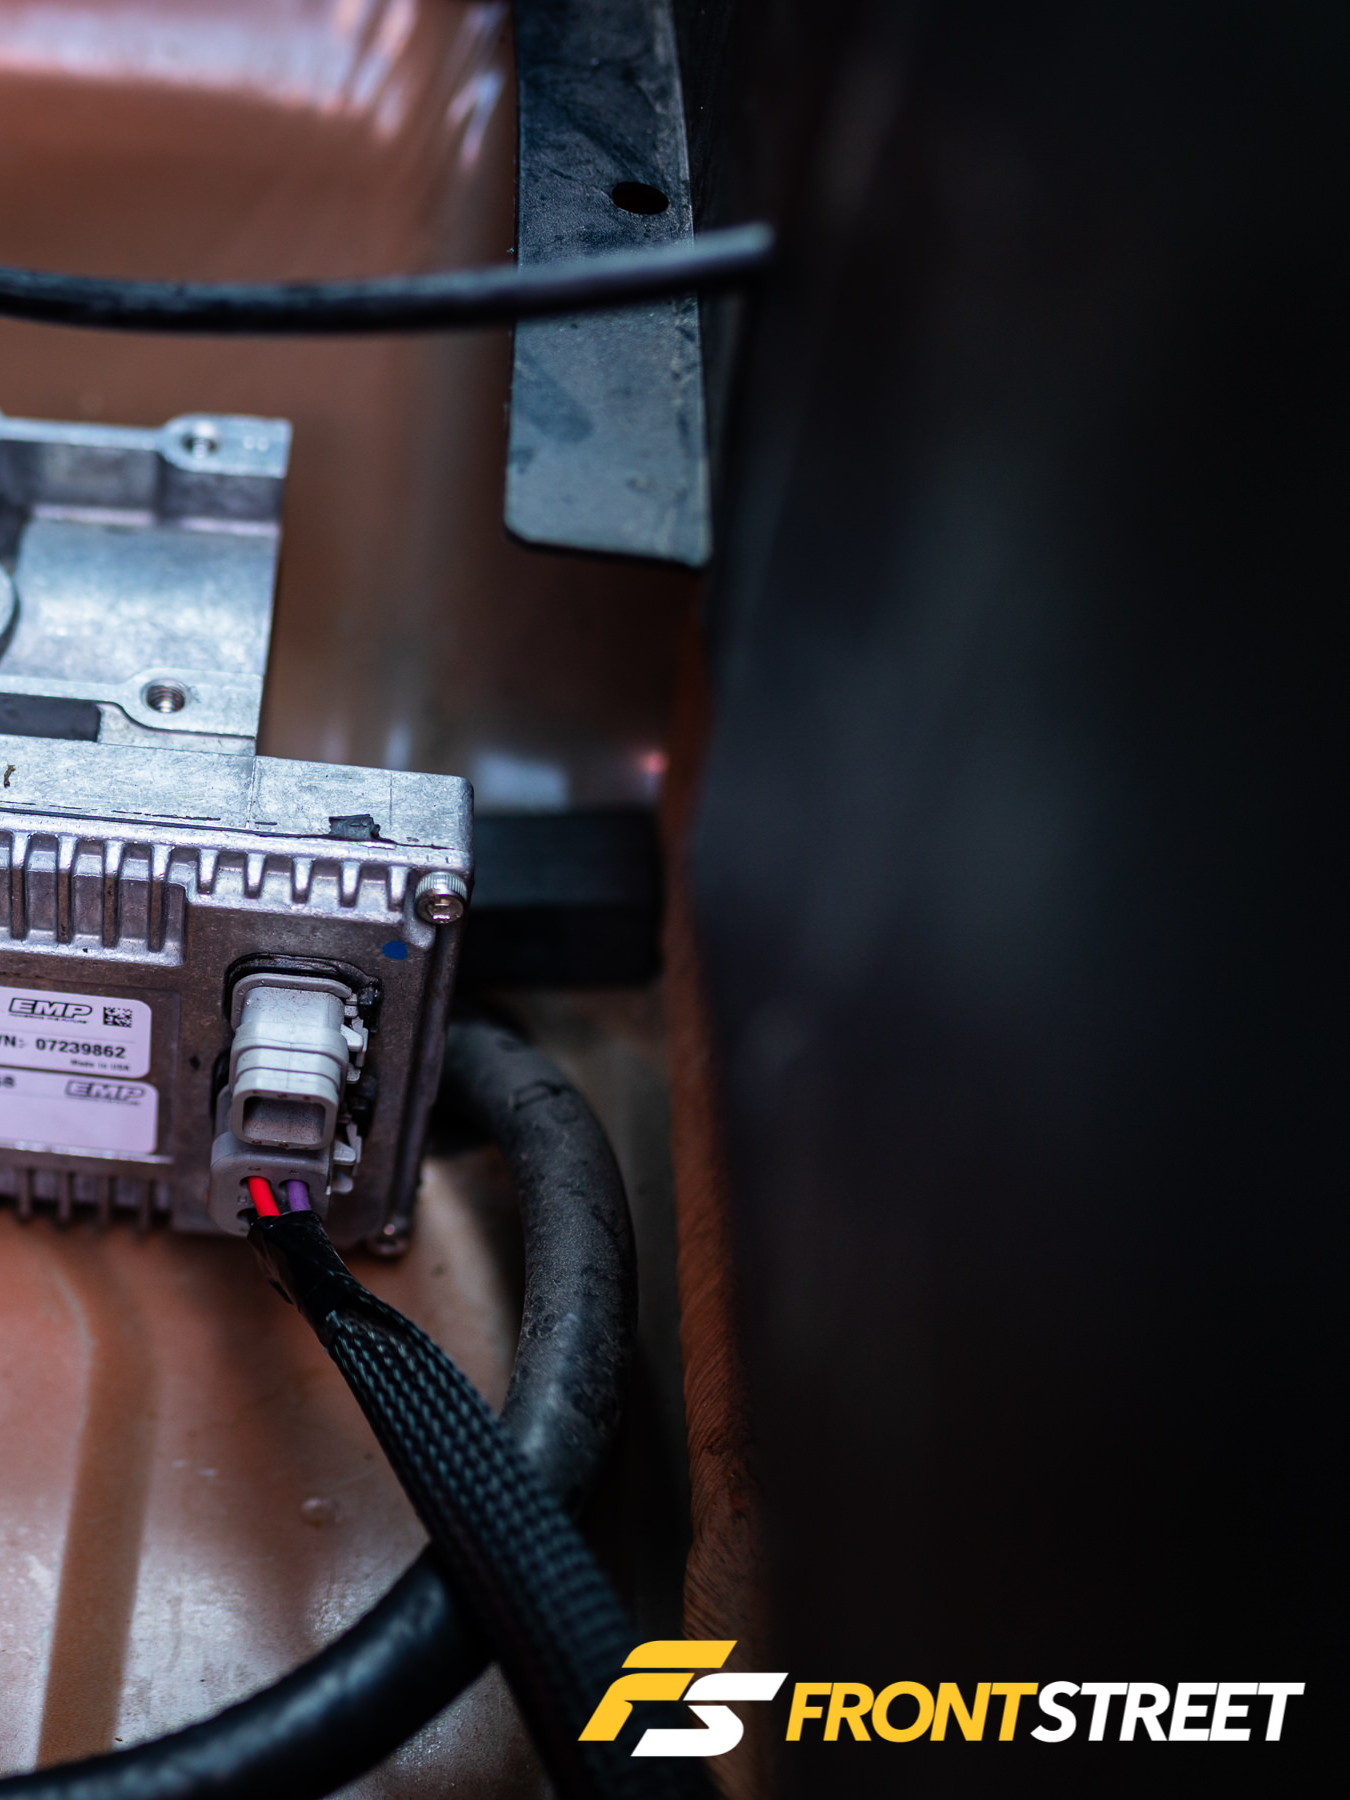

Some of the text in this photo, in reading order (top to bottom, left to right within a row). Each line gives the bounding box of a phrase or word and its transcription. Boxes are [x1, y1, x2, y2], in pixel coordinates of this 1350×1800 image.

[8, 997, 93, 1019] EMP
[36, 1038, 126, 1059] 07239862
[65, 1079, 146, 1101] EMP
